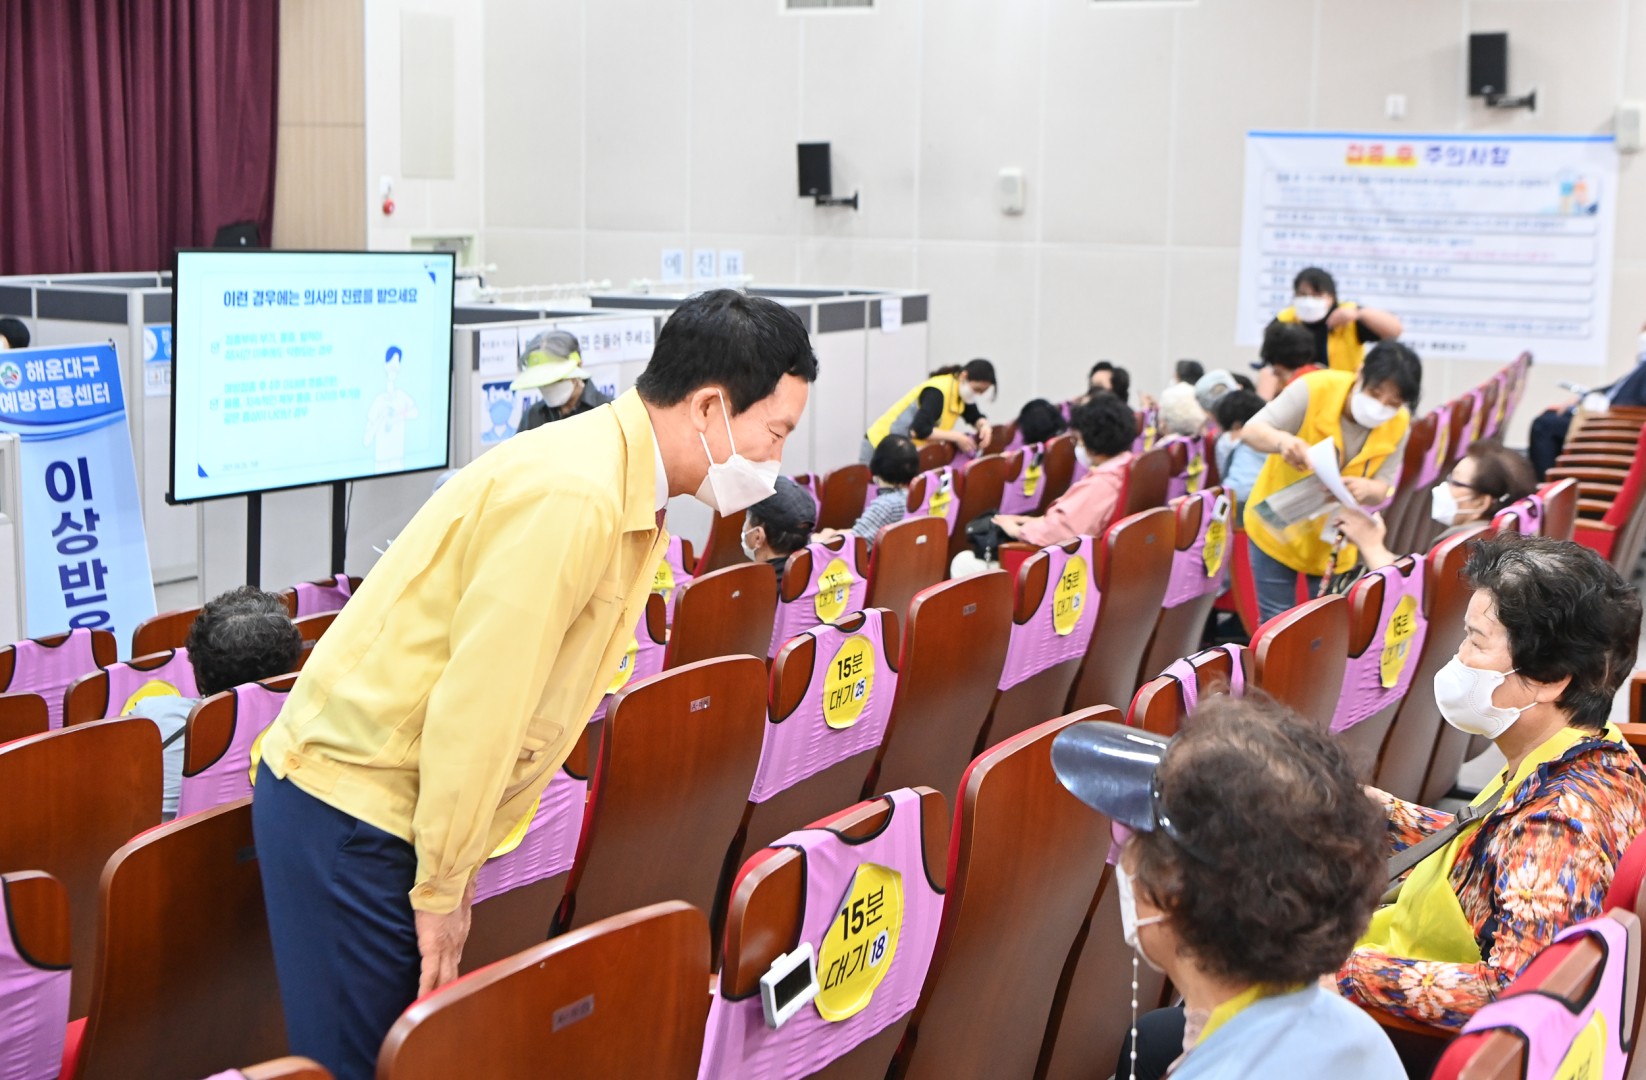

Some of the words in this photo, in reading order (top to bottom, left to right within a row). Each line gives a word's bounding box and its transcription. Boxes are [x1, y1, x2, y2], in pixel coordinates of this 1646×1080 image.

[223, 290, 248, 307] 이런
[252, 289, 300, 307] 경우에는
[304, 289, 338, 305] 의사의
[341, 287, 373, 305] 진료를
[377, 286, 418, 304] 받으세요
[25, 355, 101, 382] 해운대구
[0, 381, 111, 414] 예방접종센터
[837, 650, 863, 680] 15분
[829, 682, 855, 710] 대기
[855, 679, 865, 698] 25
[841, 885, 884, 941] 15분
[824, 939, 869, 991] 대기
[870, 935, 886, 964] 18
